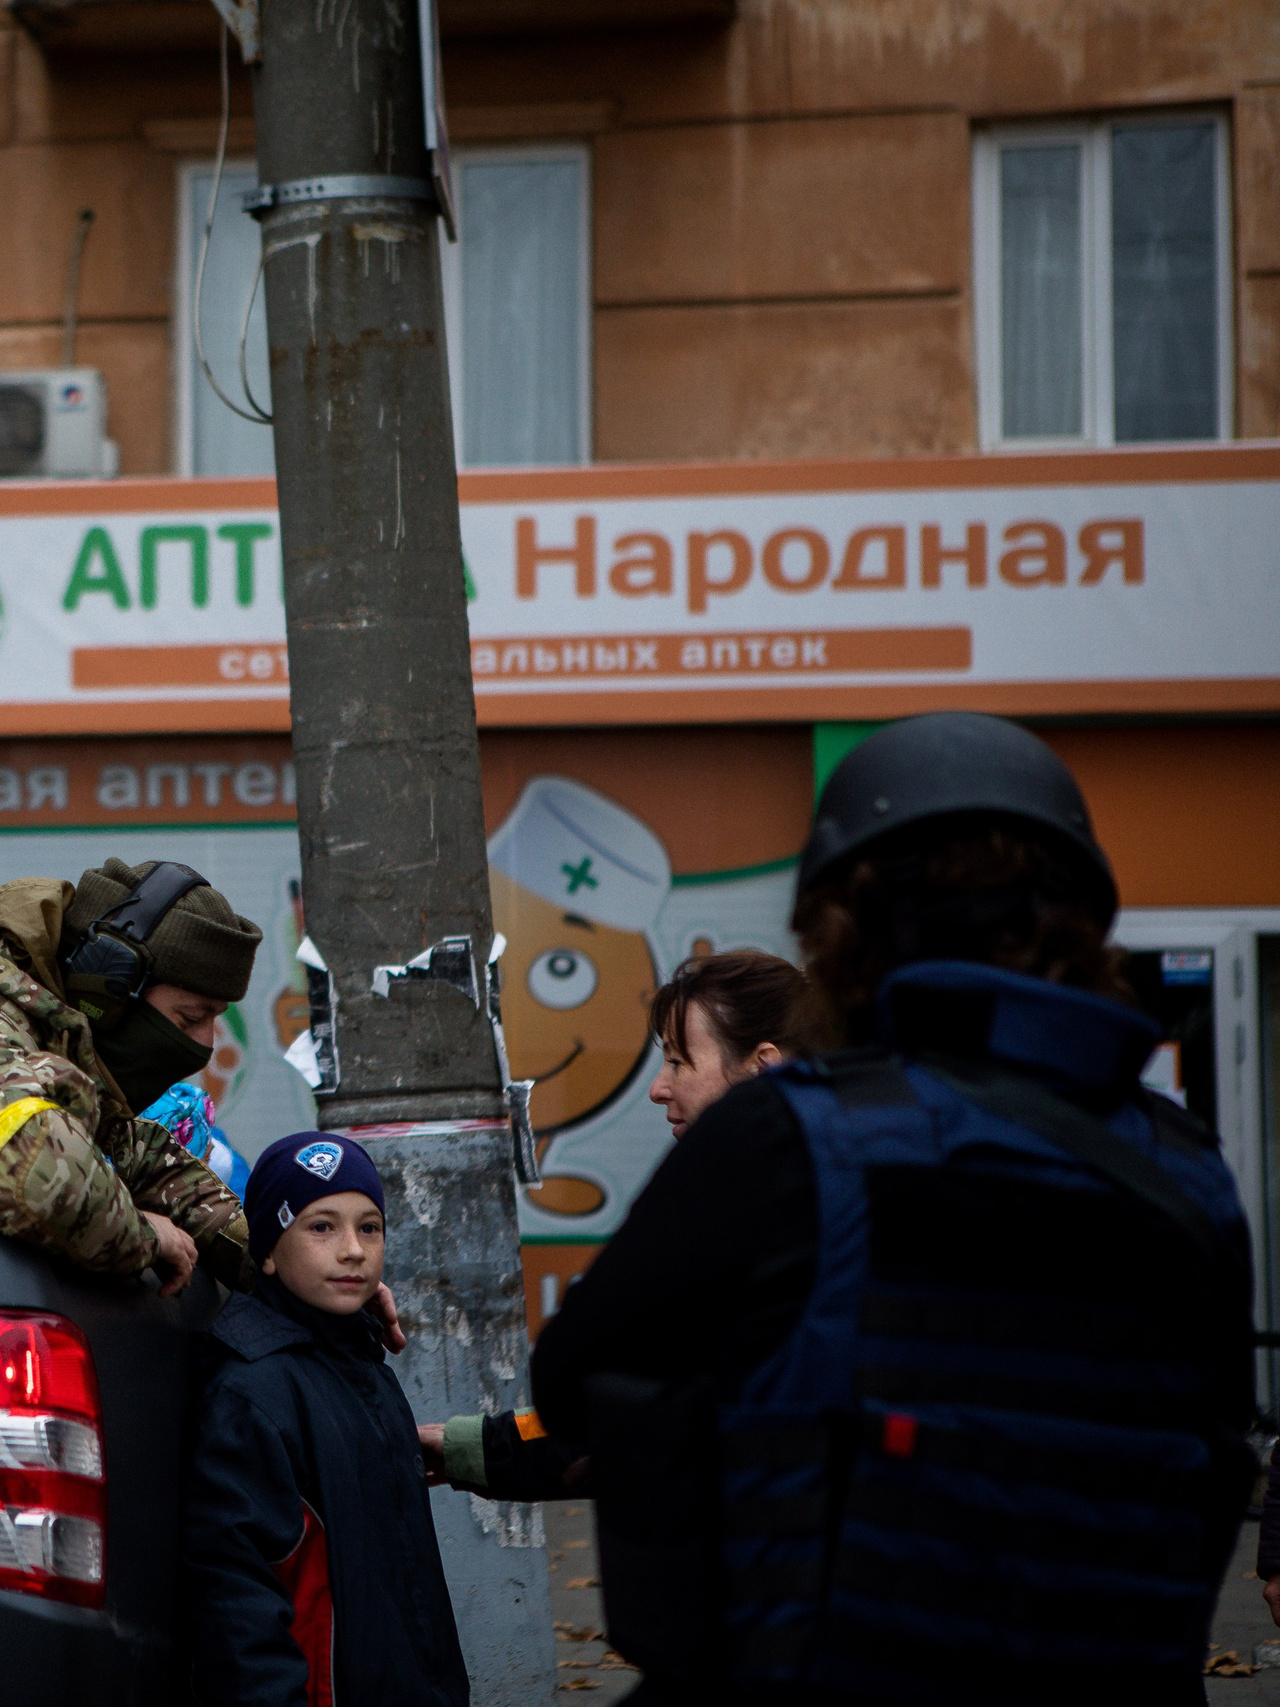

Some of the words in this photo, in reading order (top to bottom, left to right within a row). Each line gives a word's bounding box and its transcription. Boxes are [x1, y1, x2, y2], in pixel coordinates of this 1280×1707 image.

[63, 522, 476, 611] АПТ
[515, 515, 1145, 614] Народная
[472, 641, 658, 675] альных
[680, 635, 828, 669] аптек
